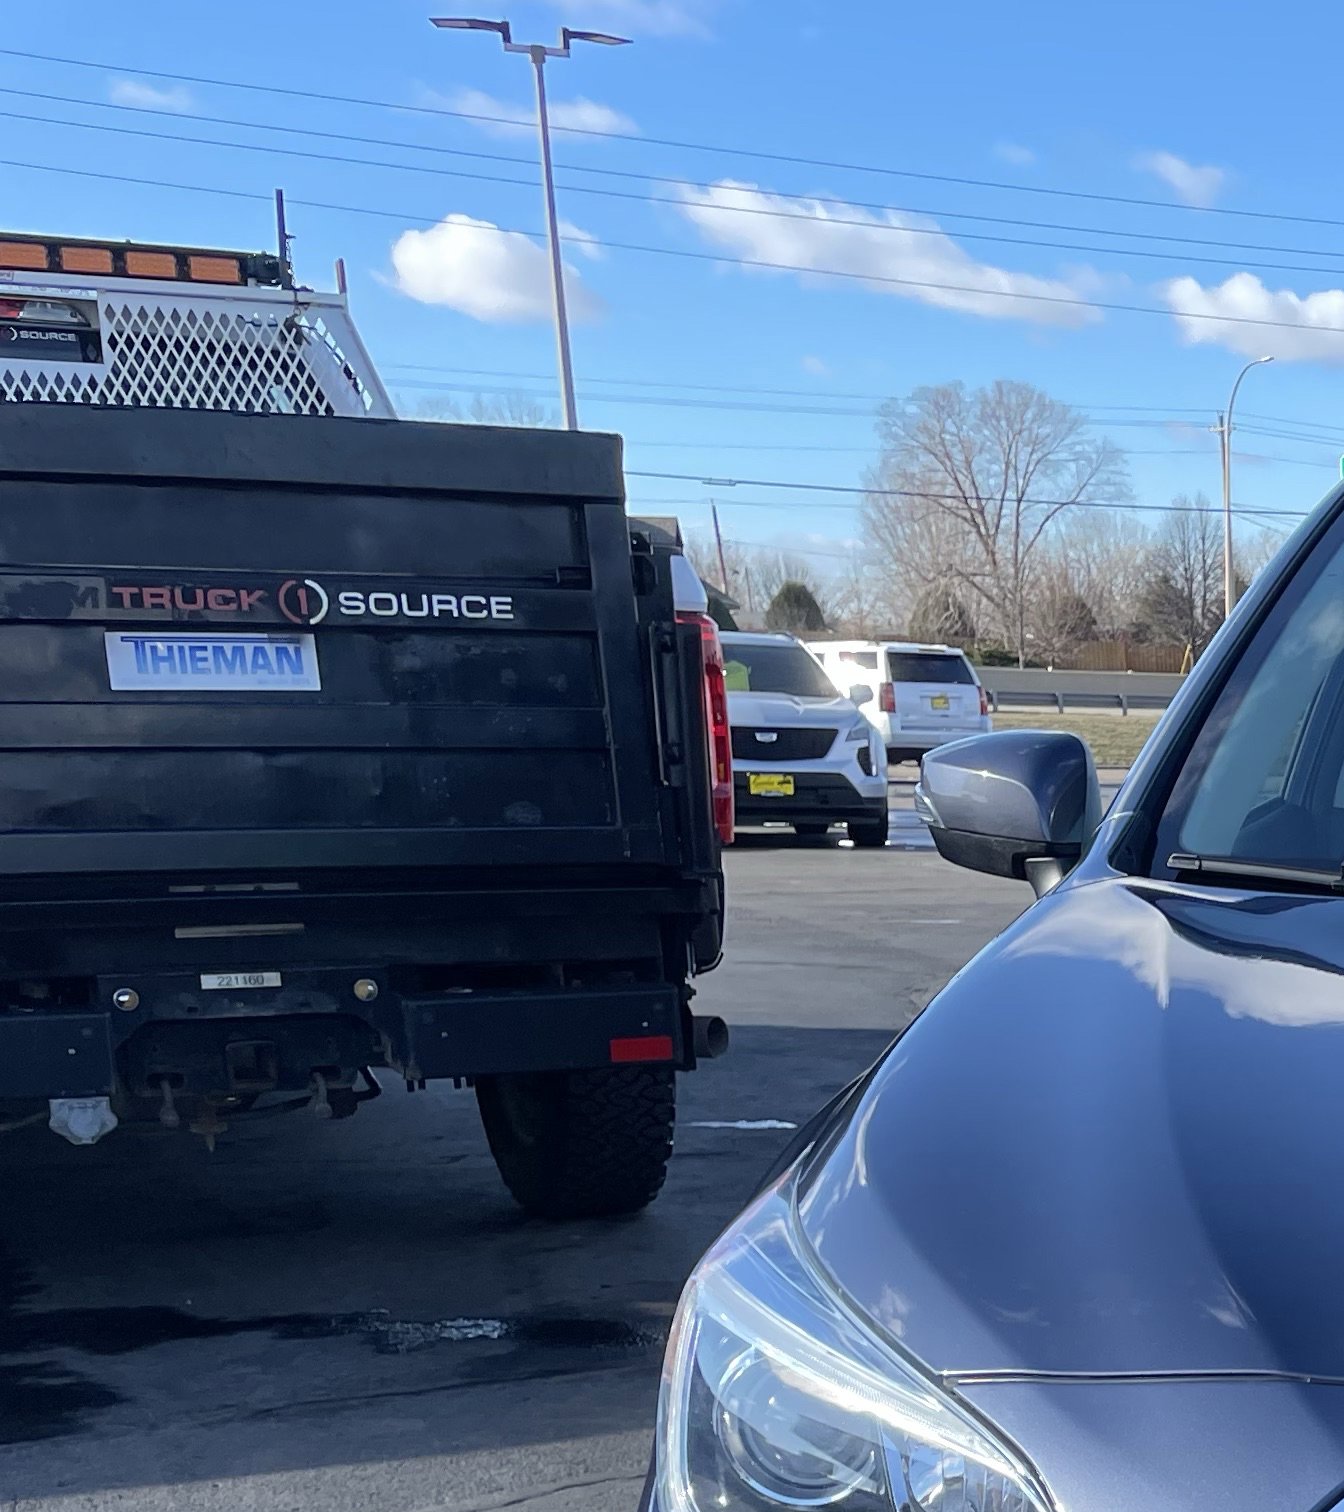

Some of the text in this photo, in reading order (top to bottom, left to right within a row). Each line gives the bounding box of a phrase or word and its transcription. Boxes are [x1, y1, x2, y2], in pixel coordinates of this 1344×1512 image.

[19, 330, 77, 342] SOURCE
[111, 586, 267, 611] TRUCK
[338, 591, 514, 619] SOURCE
[120, 635, 304, 676] THIEMAN
